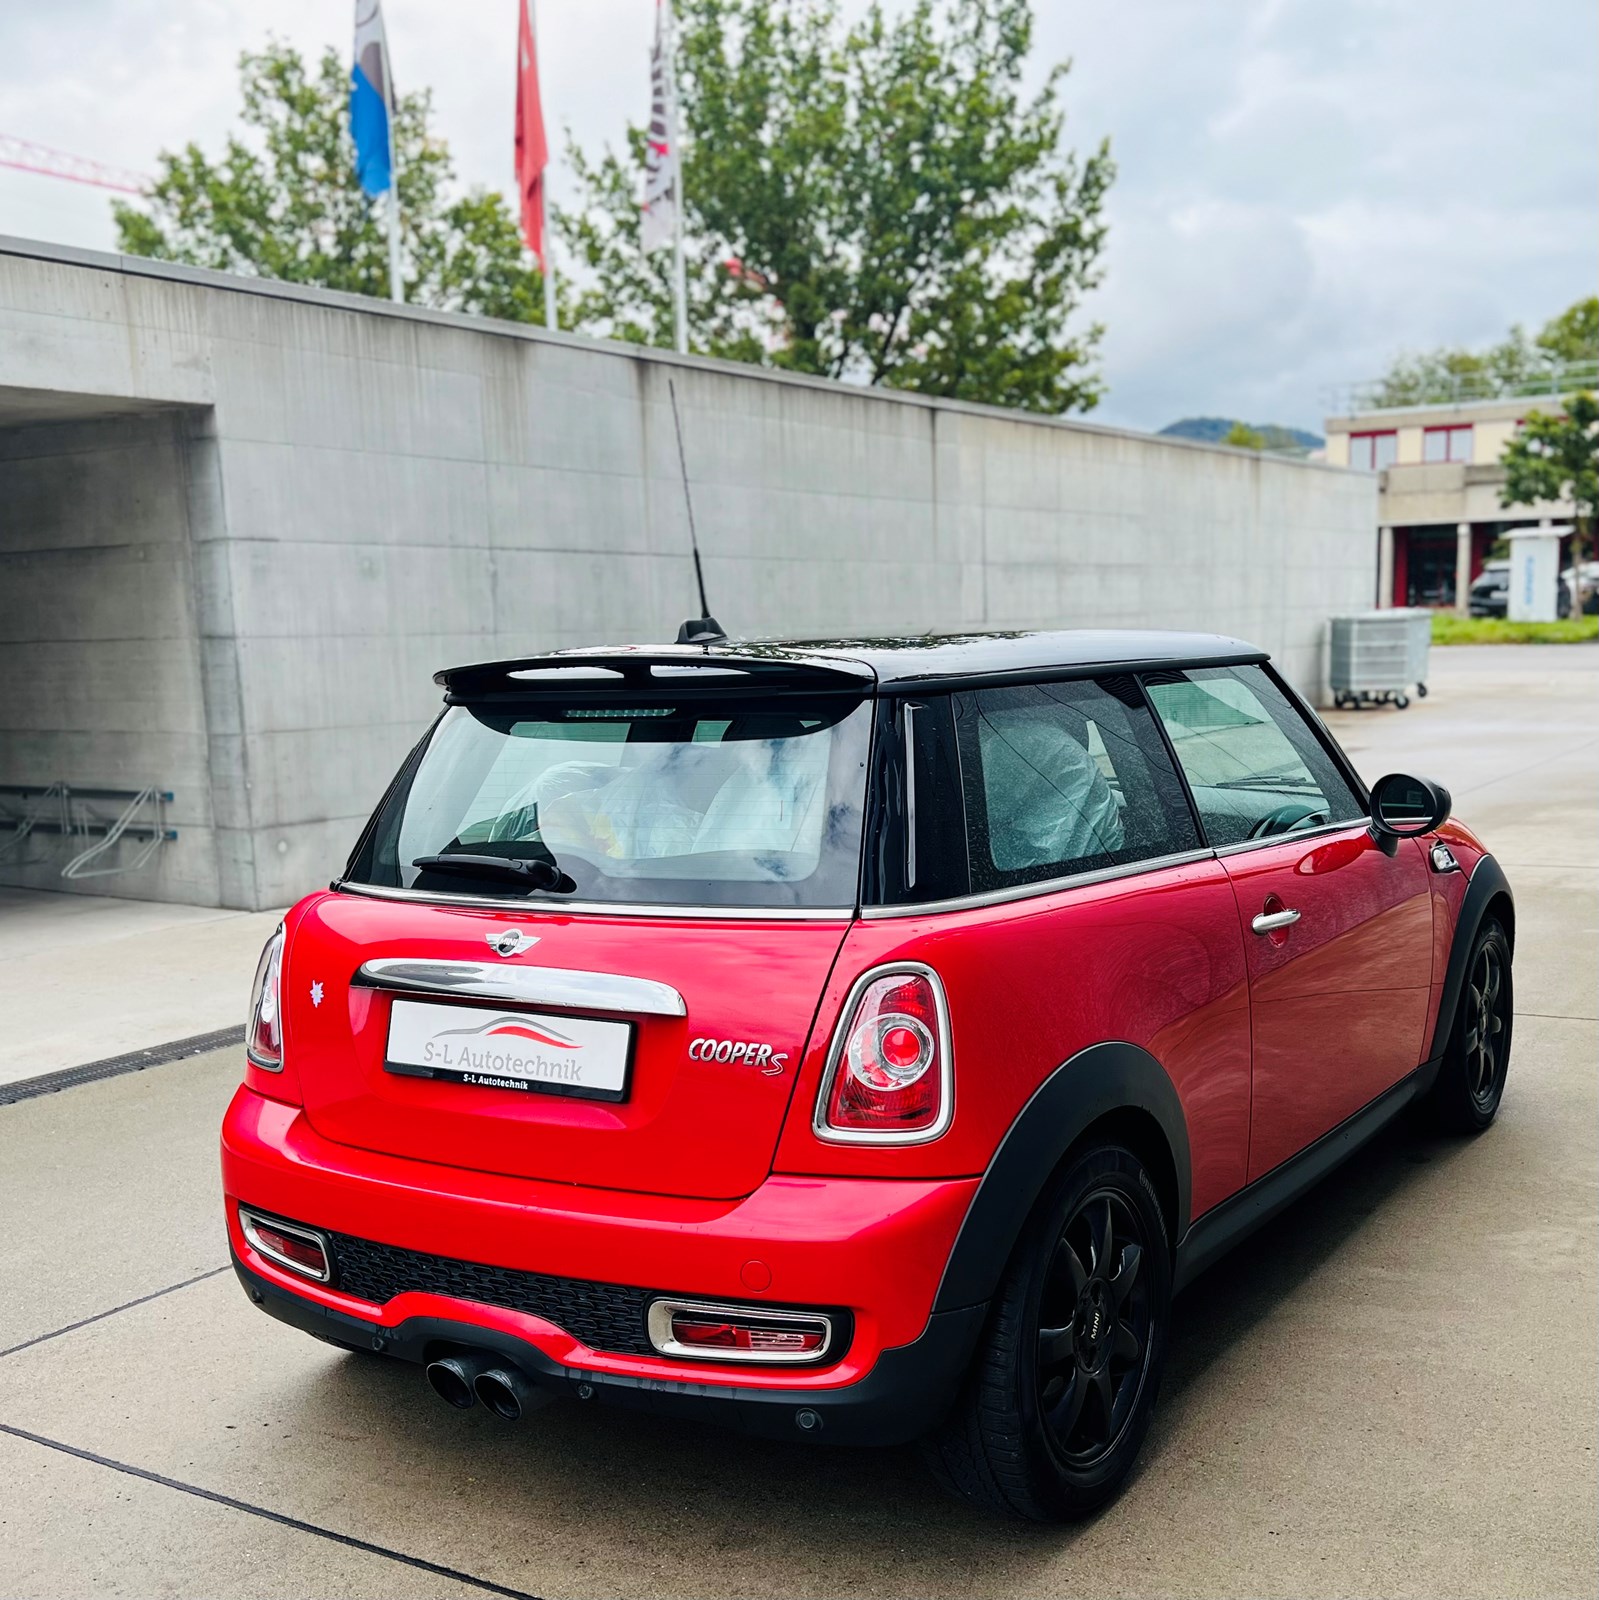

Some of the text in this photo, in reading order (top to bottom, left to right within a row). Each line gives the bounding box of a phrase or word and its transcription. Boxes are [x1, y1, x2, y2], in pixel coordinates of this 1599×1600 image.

[500, 937, 518, 946] MINI
[423, 1042, 582, 1081] S-L Autotechnik
[688, 1038, 789, 1076] COOPER S
[463, 1074, 529, 1090] S-L Autotechnik
[1091, 1312, 1100, 1339] MINI
